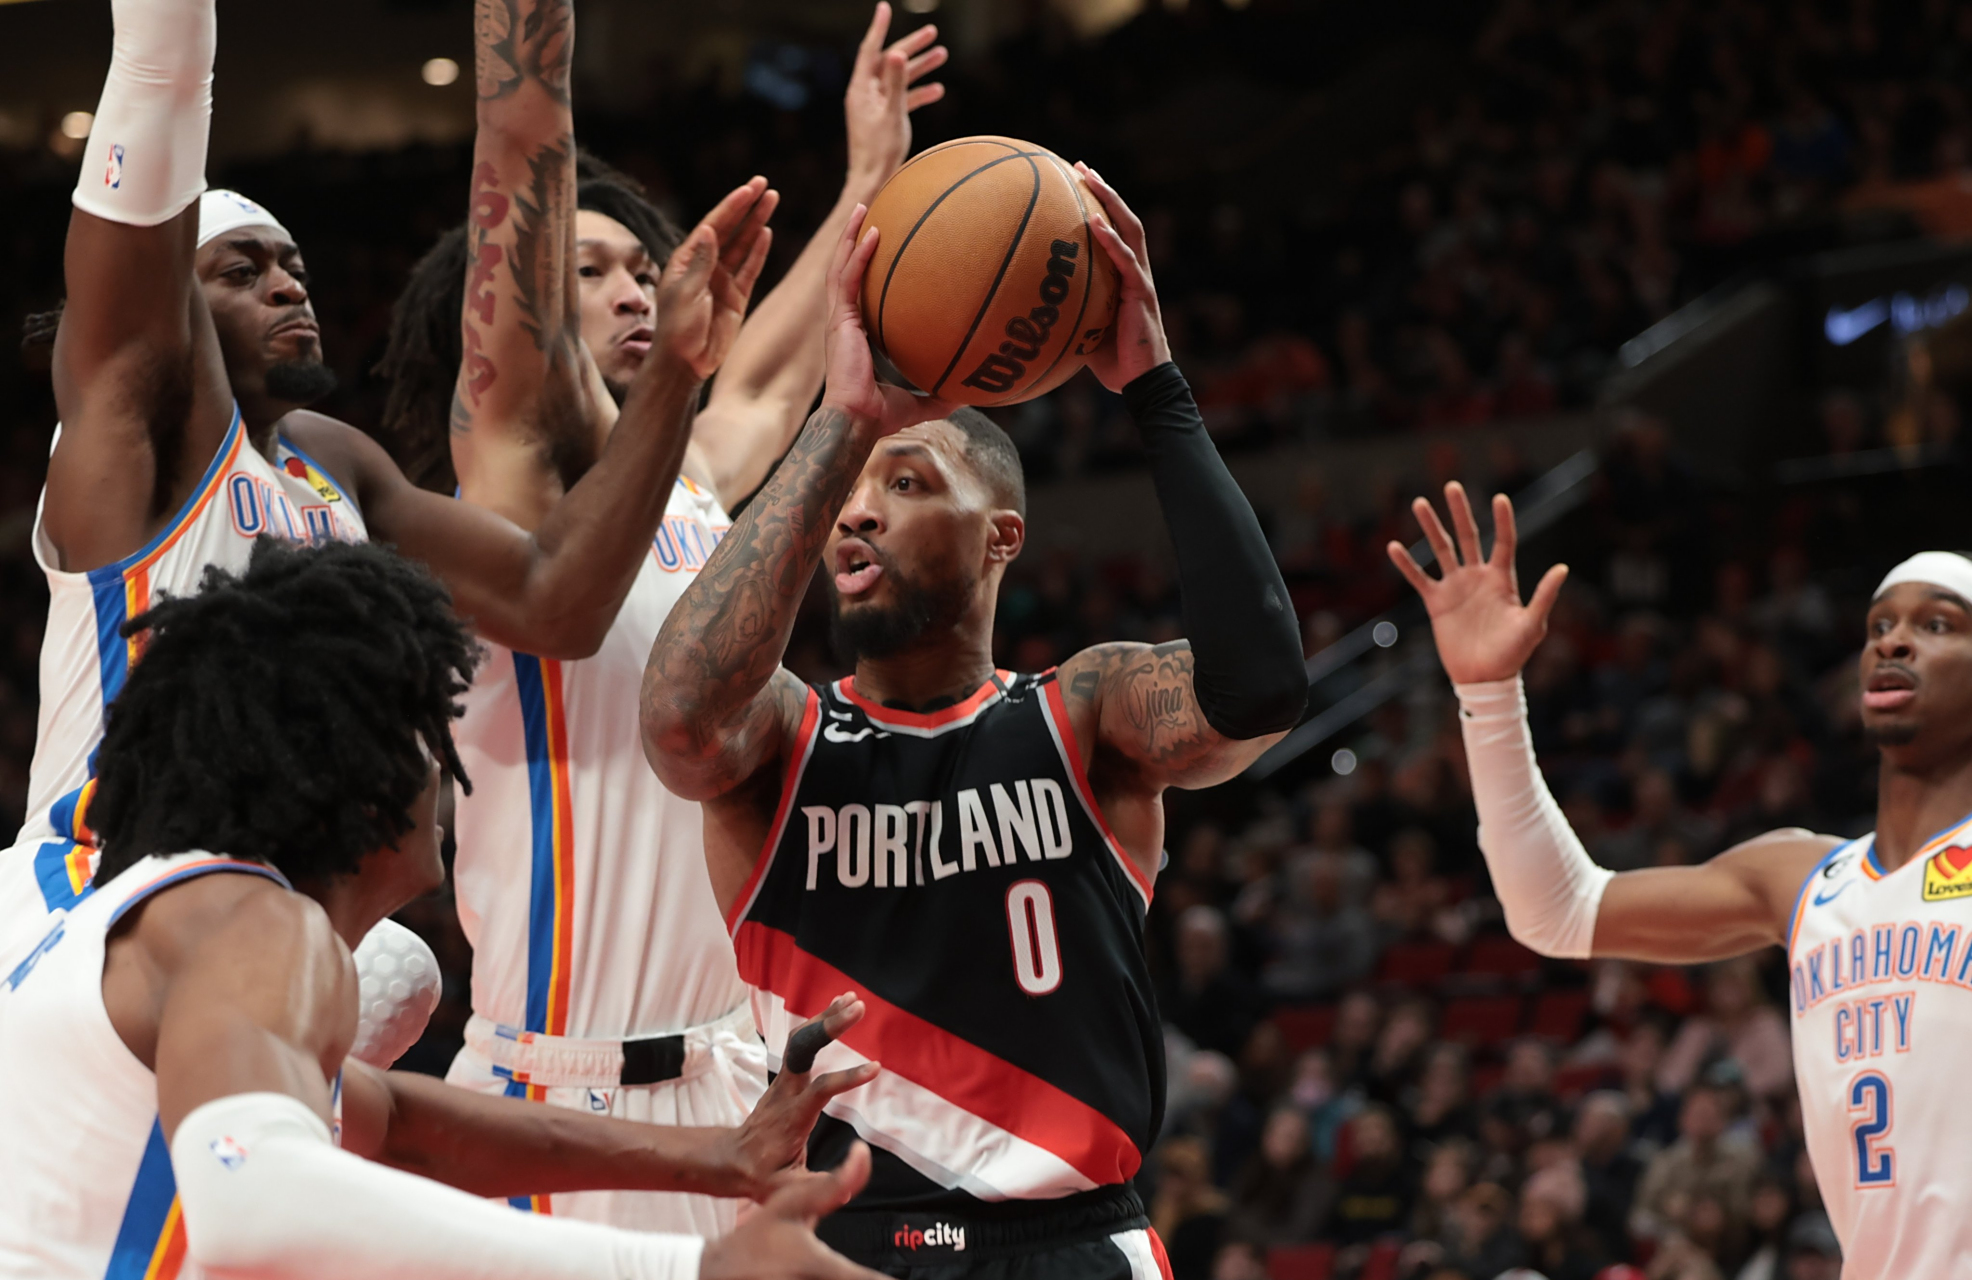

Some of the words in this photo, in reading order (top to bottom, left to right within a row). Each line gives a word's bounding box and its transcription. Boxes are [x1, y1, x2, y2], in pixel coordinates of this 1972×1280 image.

[961, 239, 1079, 394] Wilson
[800, 777, 1073, 891] PORTLAND
[1005, 878, 1063, 996] 0
[1834, 991, 1916, 1065] CITY
[1847, 1069, 1897, 1191] 2
